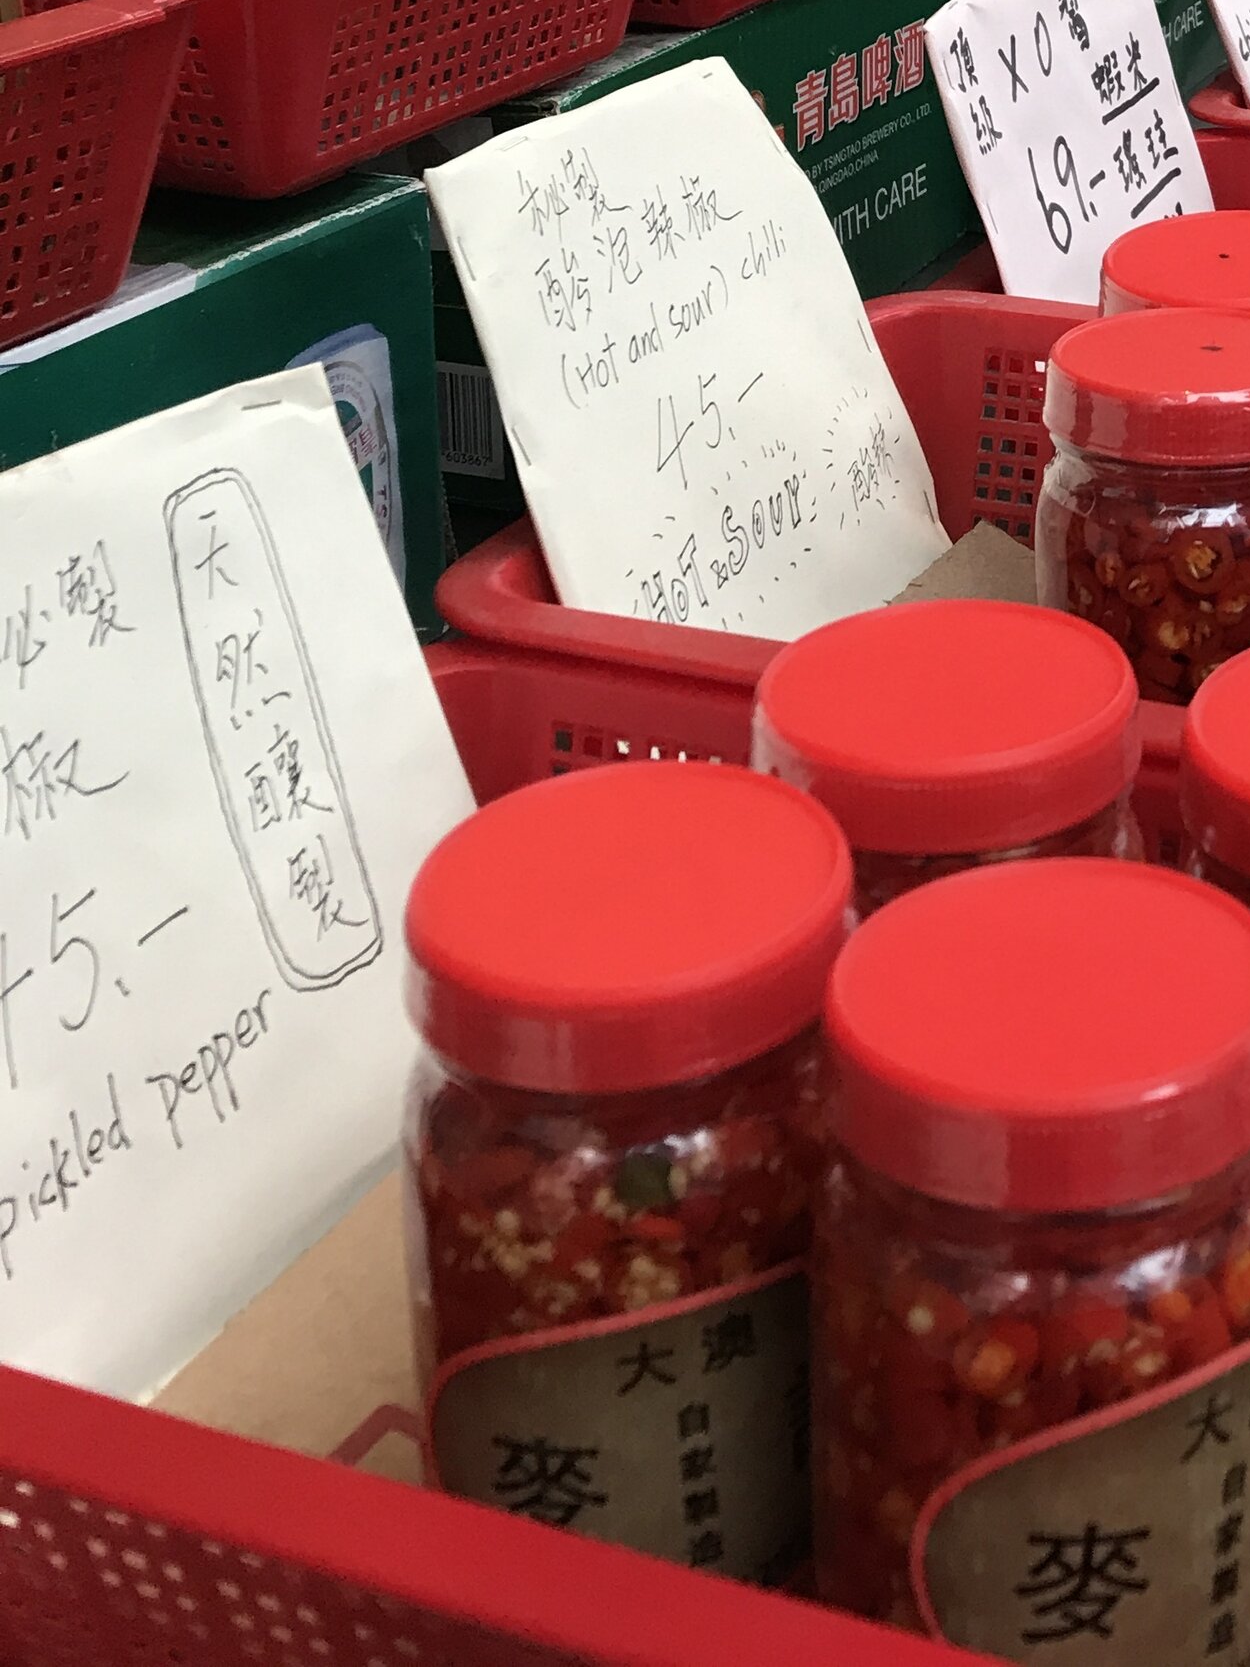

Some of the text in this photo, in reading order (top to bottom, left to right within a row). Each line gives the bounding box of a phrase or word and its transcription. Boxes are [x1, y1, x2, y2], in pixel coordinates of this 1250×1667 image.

[792, 17, 926, 152] 青島啤酒
[1090, 31, 1149, 107] 蝦米
[1173, 0, 1205, 43] CARE
[823, 139, 862, 171] TSINGTAO
[861, 118, 900, 151] BREWERY
[949, 26, 1003, 157] 頂級
[517, 146, 633, 244] 秘製
[534, 174, 744, 333] 酸泡辣椒
[874, 162, 929, 222] CARE
[628, 301, 665, 364] and
[668, 264, 730, 340] sour)
[740, 219, 787, 280] chili
[194, 508, 371, 934] 天然釀製
[0, 987, 272, 1281] pickled pepper
[617, 1309, 757, 1398] 大澳
[1016, 1521, 1151, 1648] 麥
